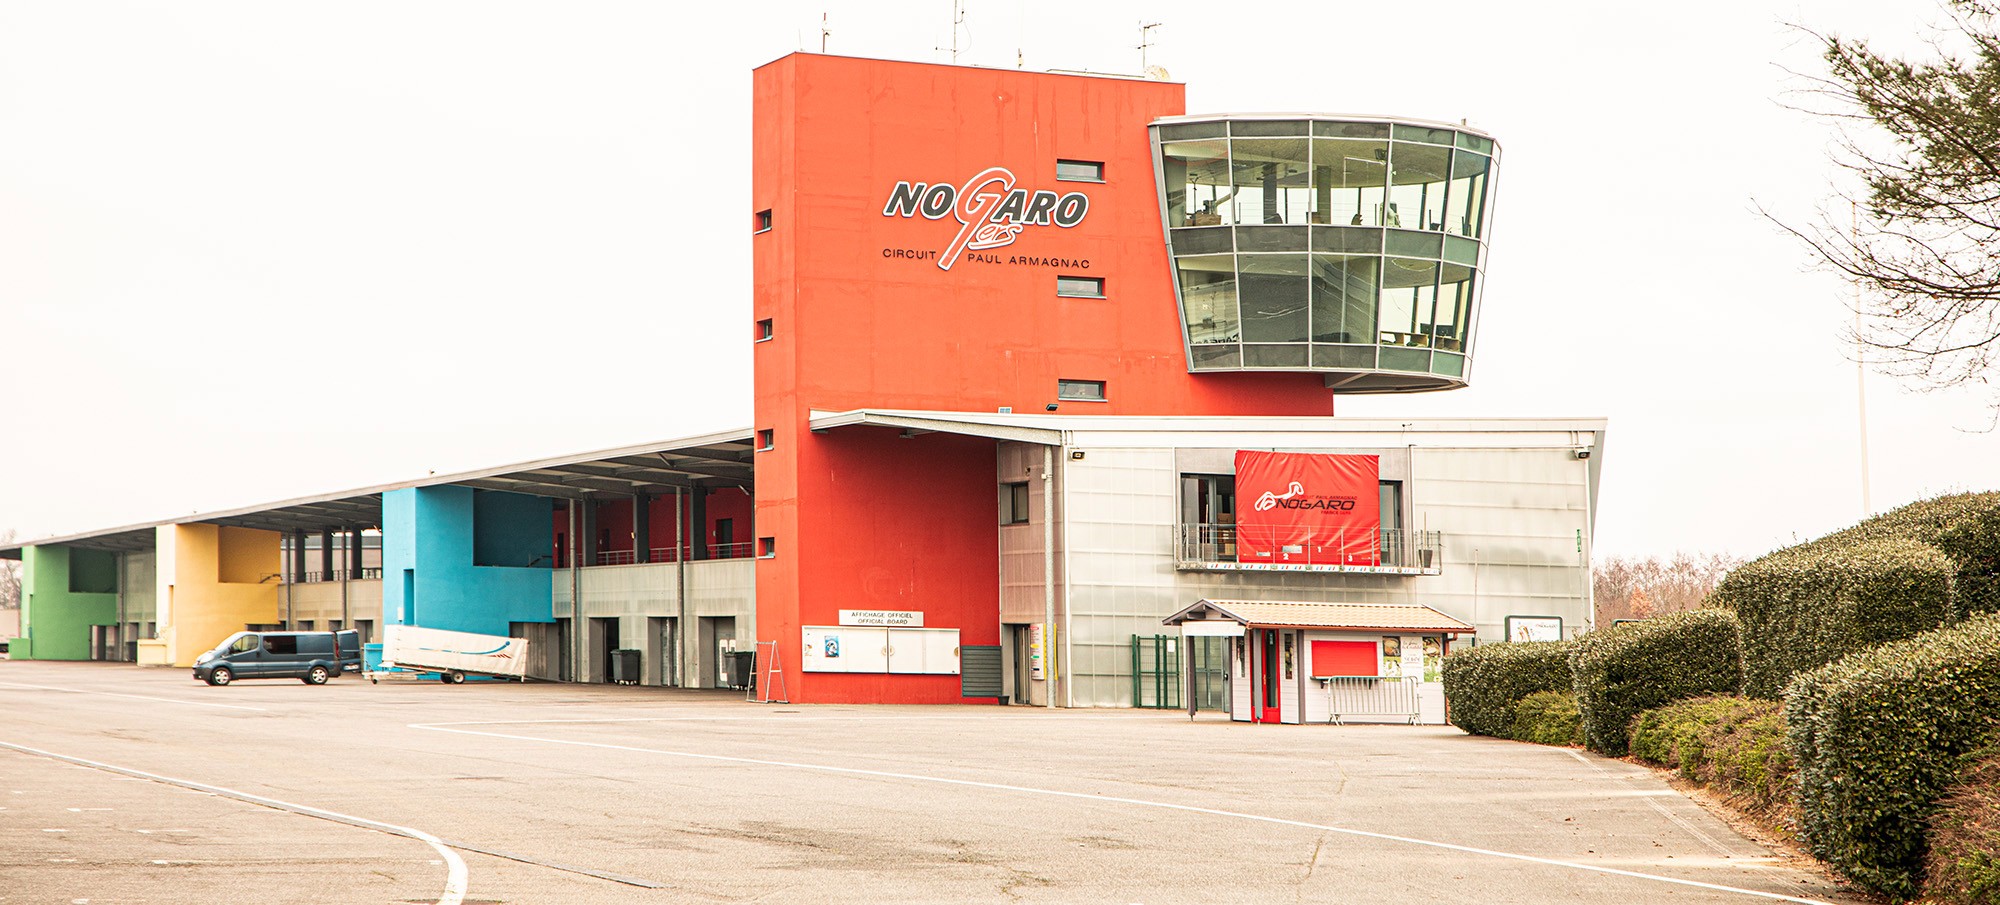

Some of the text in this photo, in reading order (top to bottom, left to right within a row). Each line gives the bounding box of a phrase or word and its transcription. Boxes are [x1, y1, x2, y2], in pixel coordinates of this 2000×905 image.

[882, 167, 1089, 270] NOGARO
[882, 249, 1090, 269] CIRCUIT PAUL ARMAGNAC
[1276, 498, 1355, 510] NOGARO
